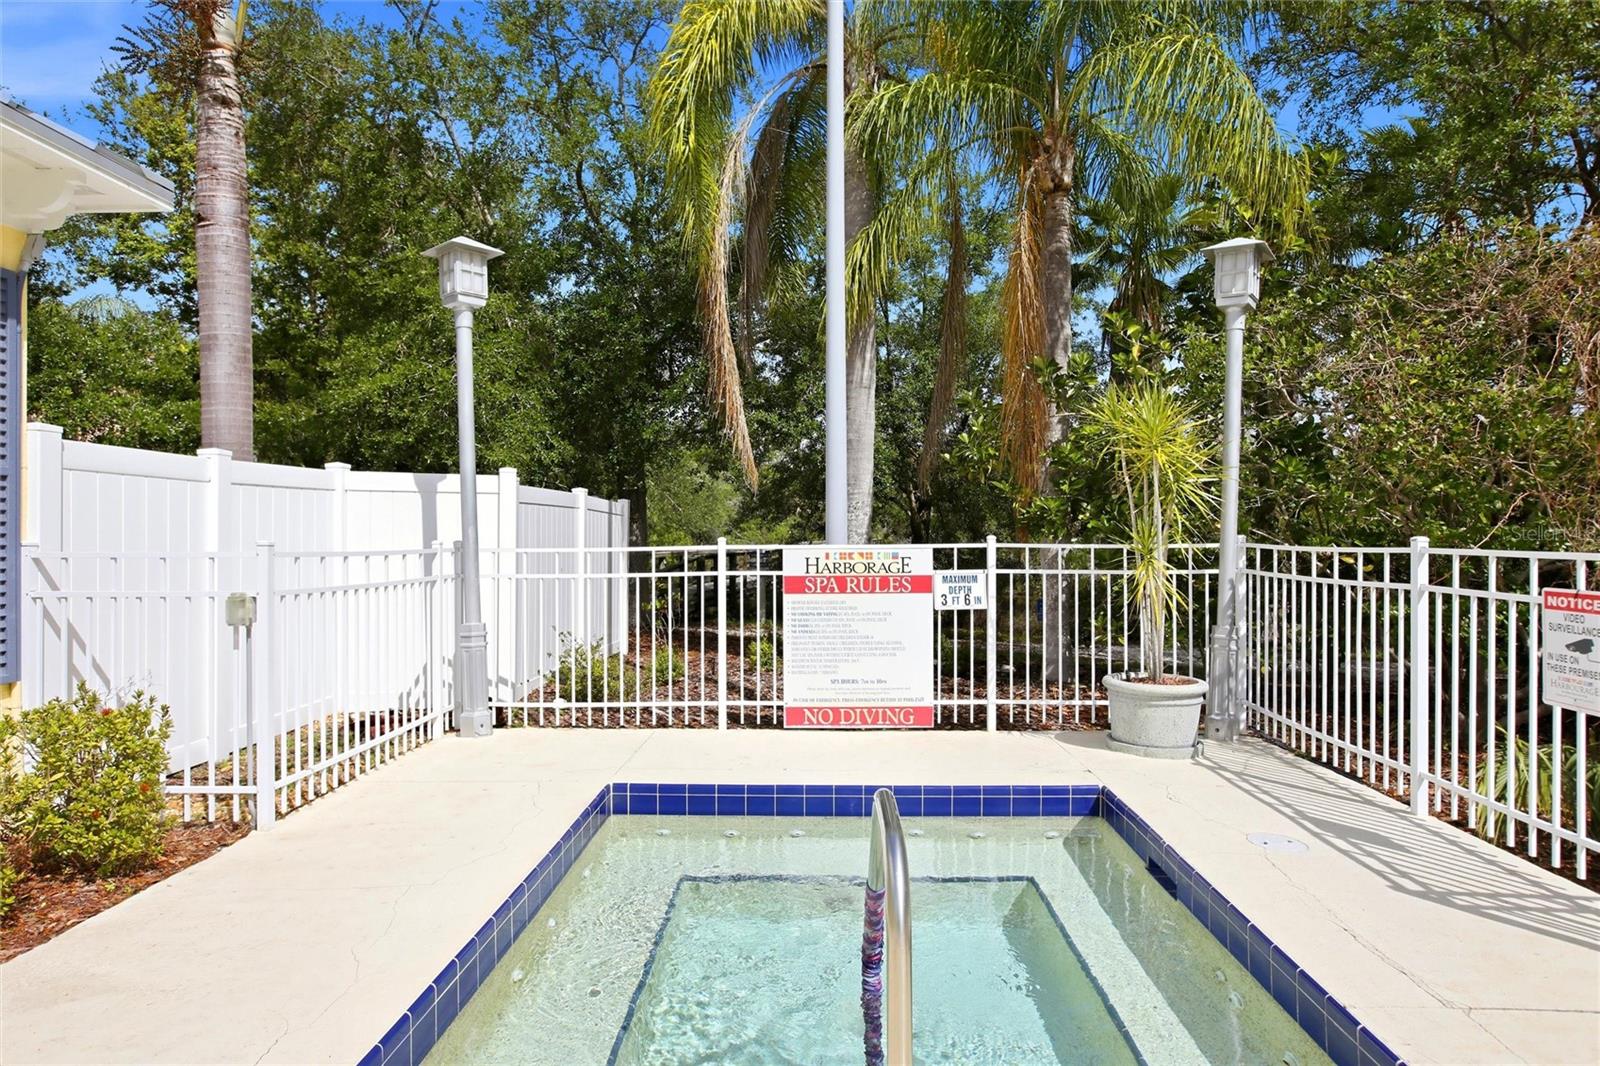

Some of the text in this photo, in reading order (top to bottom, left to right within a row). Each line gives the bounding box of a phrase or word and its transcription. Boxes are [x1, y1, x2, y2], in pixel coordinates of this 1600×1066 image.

[804, 556, 912, 575] HARBORAGE
[804, 576, 912, 594] SPA RULES
[942, 575, 978, 585] MAXIMUM
[948, 585, 972, 595] DEPTH
[941, 594, 982, 606] 3 FT 6 IN
[1546, 595, 1600, 611] NOTICE
[1563, 613, 1586, 624] VIDEO
[1547, 652, 1580, 665] IN USE ON
[1547, 662, 1600, 681] THESE PREMISE
[803, 708, 915, 725] NO DIVING
